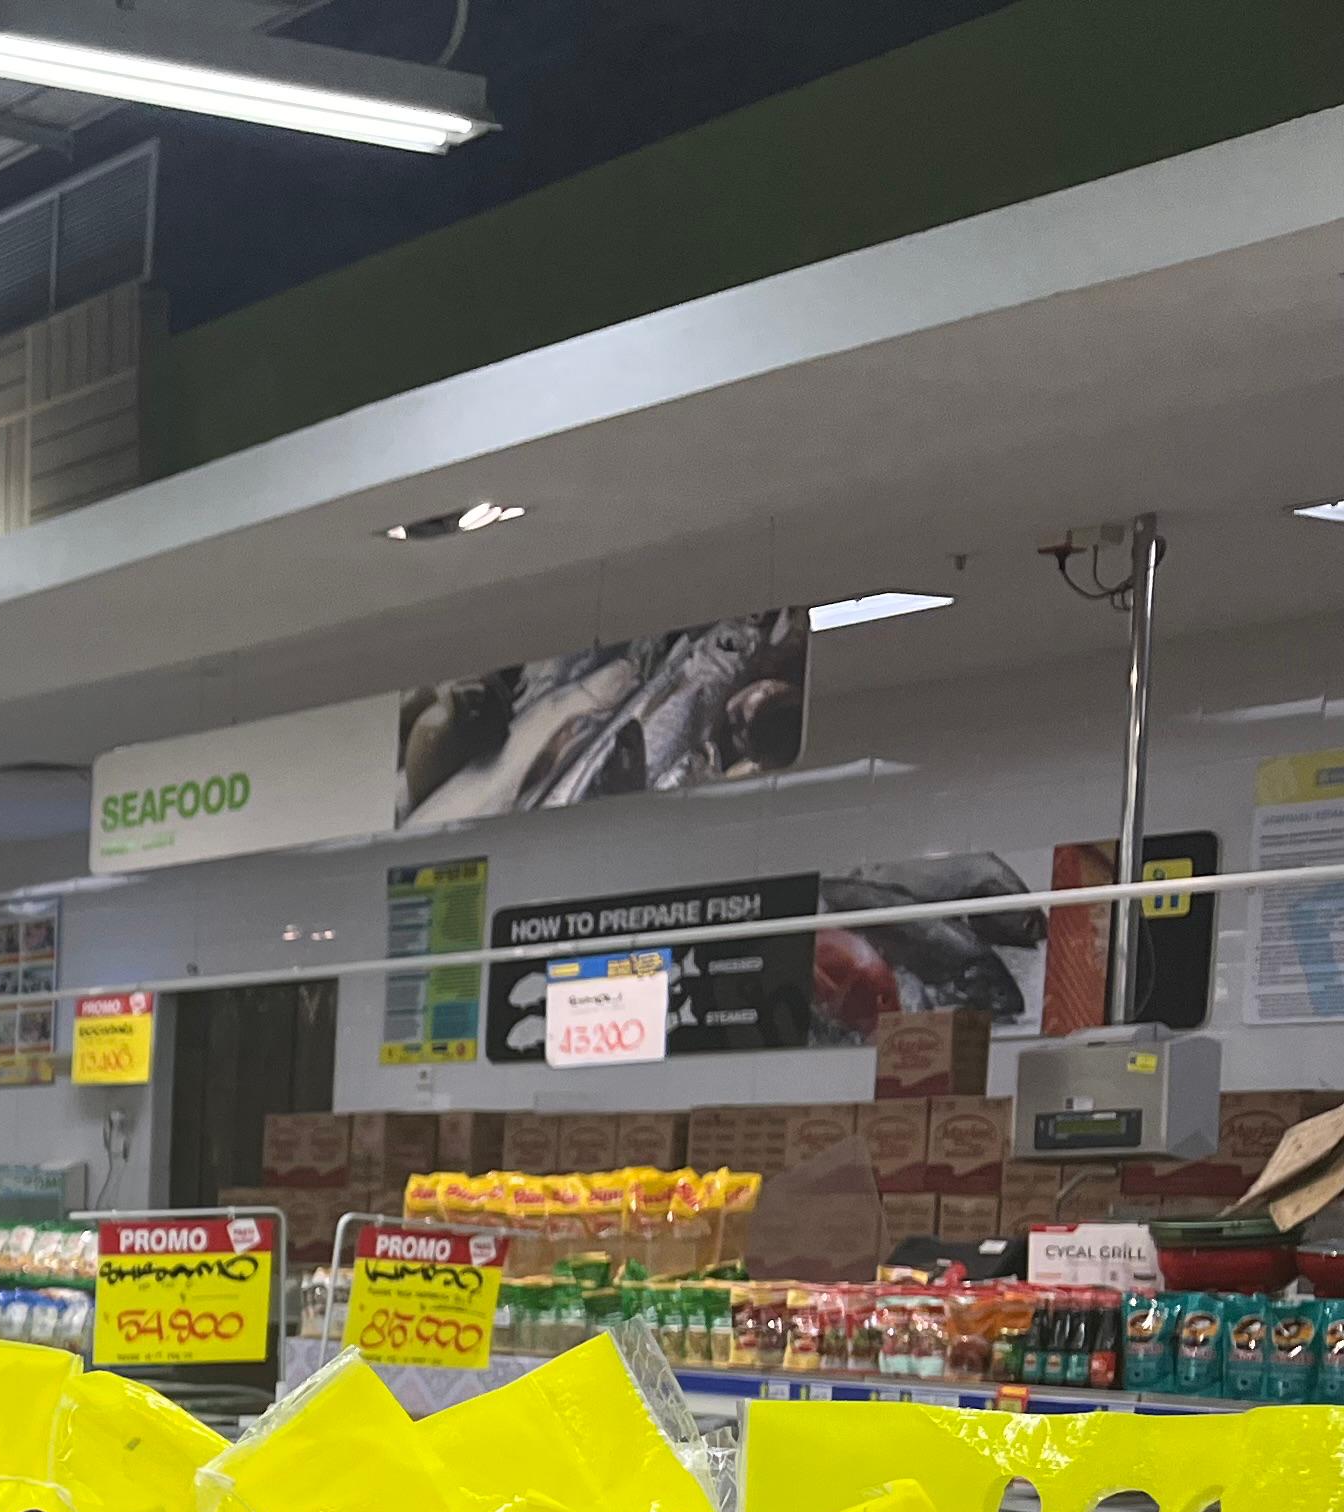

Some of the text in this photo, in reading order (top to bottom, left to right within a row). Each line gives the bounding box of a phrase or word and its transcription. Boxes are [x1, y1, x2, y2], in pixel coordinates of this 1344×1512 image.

[101, 771, 251, 833] SEAFOOD
[511, 893, 762, 943] HOW TO PREPARE FISH
[119, 1226, 209, 1254] PROMO
[375, 1234, 452, 1262] PROMO
